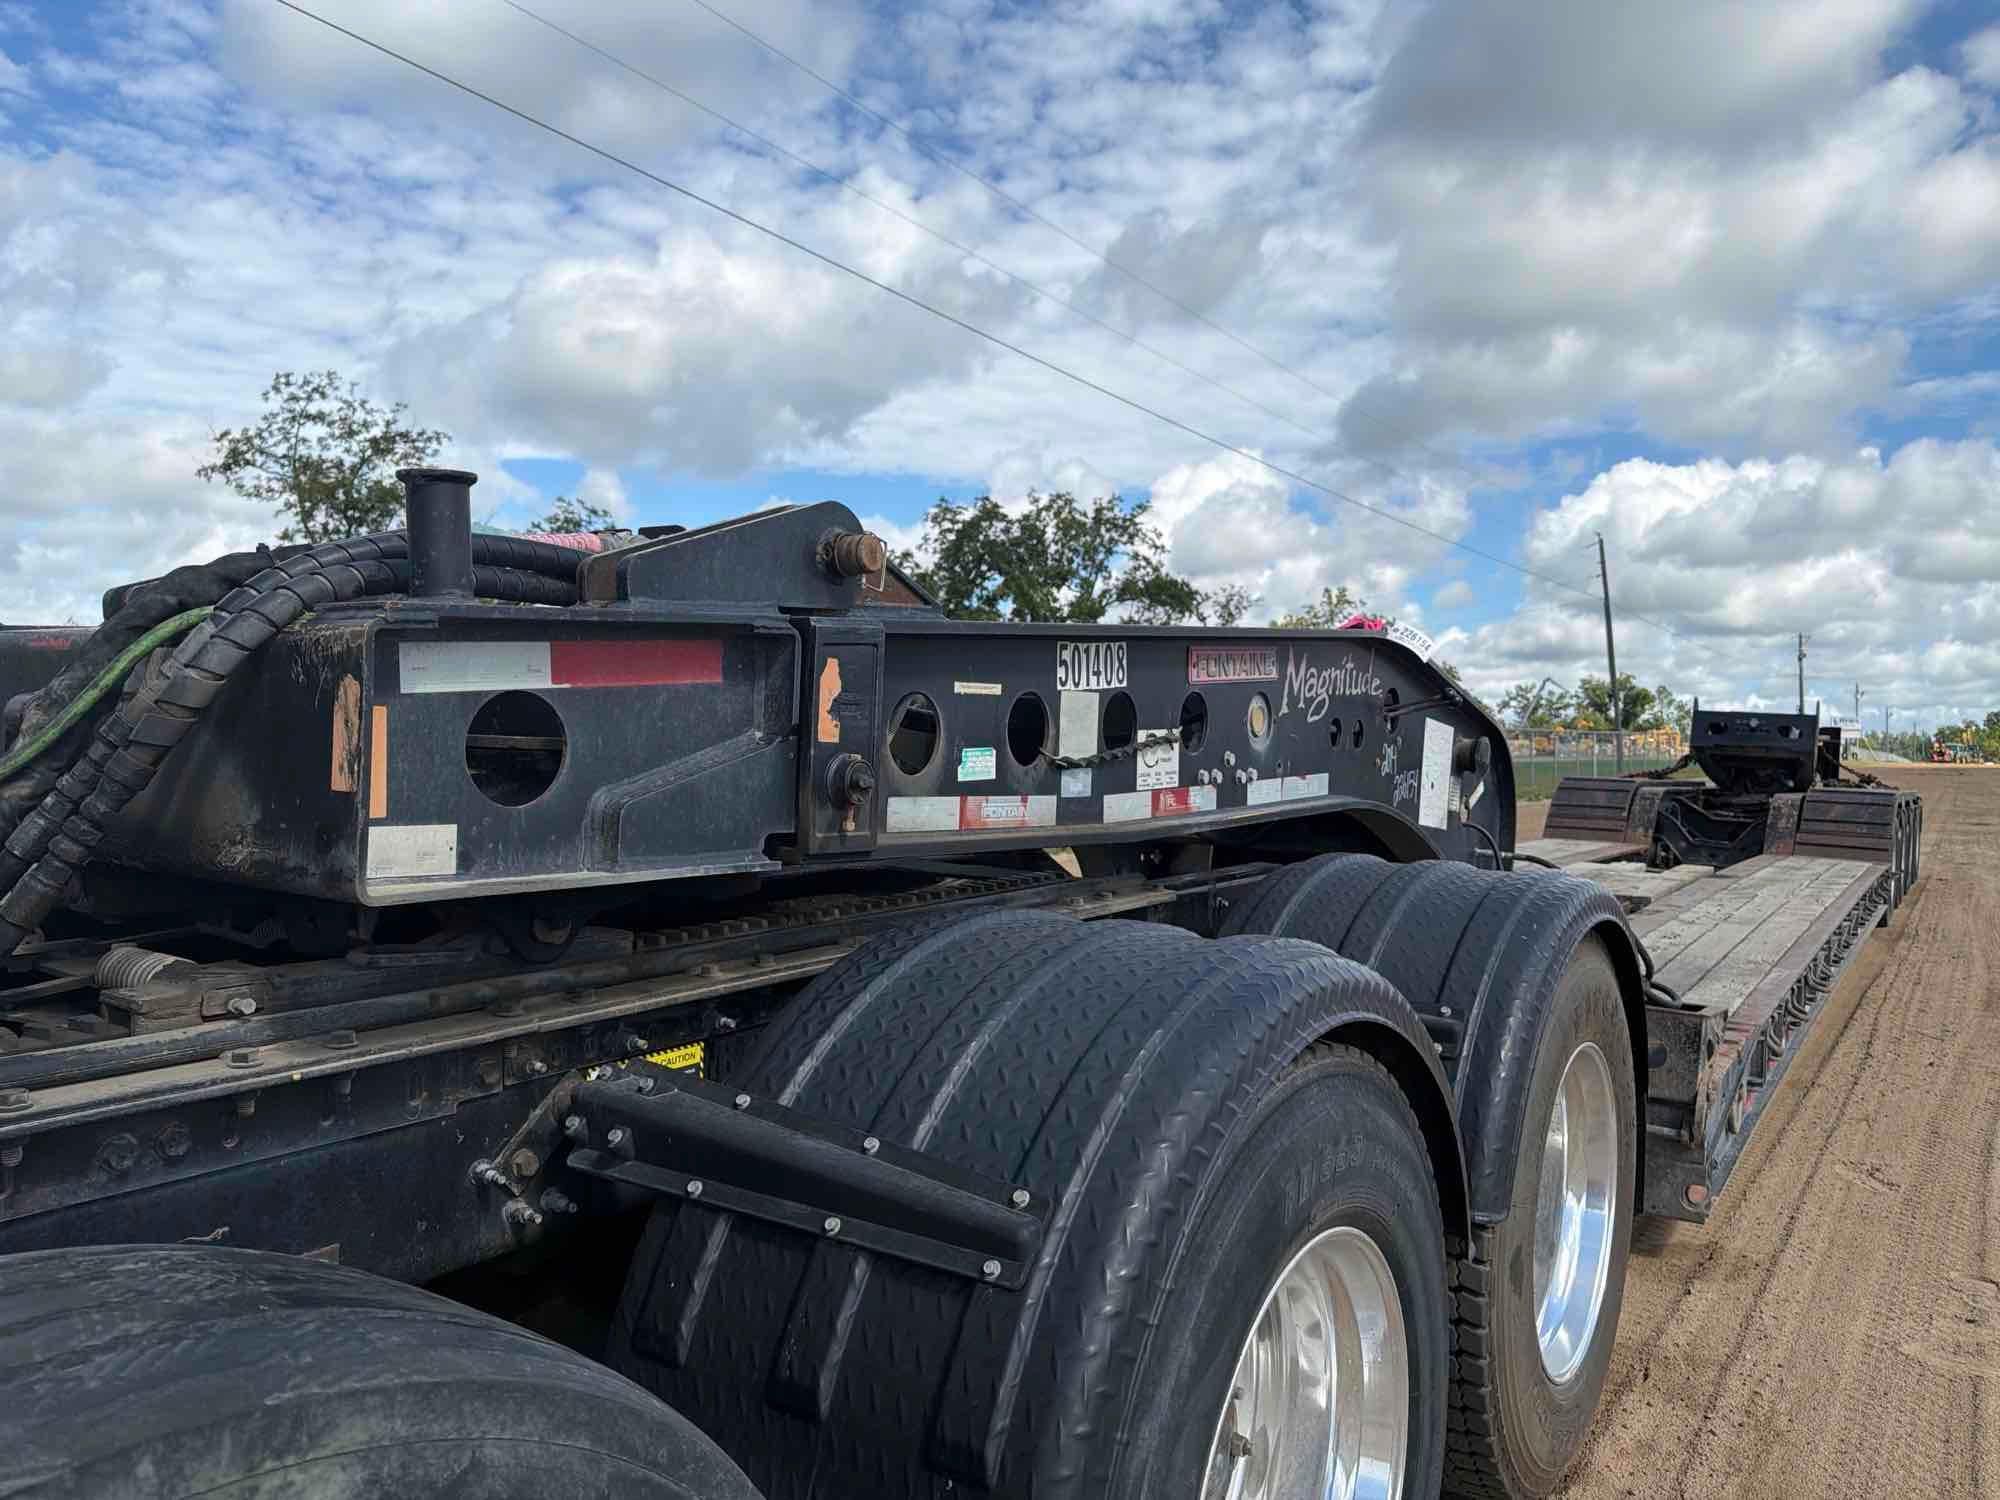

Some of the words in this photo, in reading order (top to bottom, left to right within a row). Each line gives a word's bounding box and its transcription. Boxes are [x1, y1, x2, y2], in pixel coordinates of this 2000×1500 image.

[1058, 643, 1126, 688] 501408
[1279, 642, 1384, 722] Magnitude
[661, 1052, 696, 1065] CAUTION
